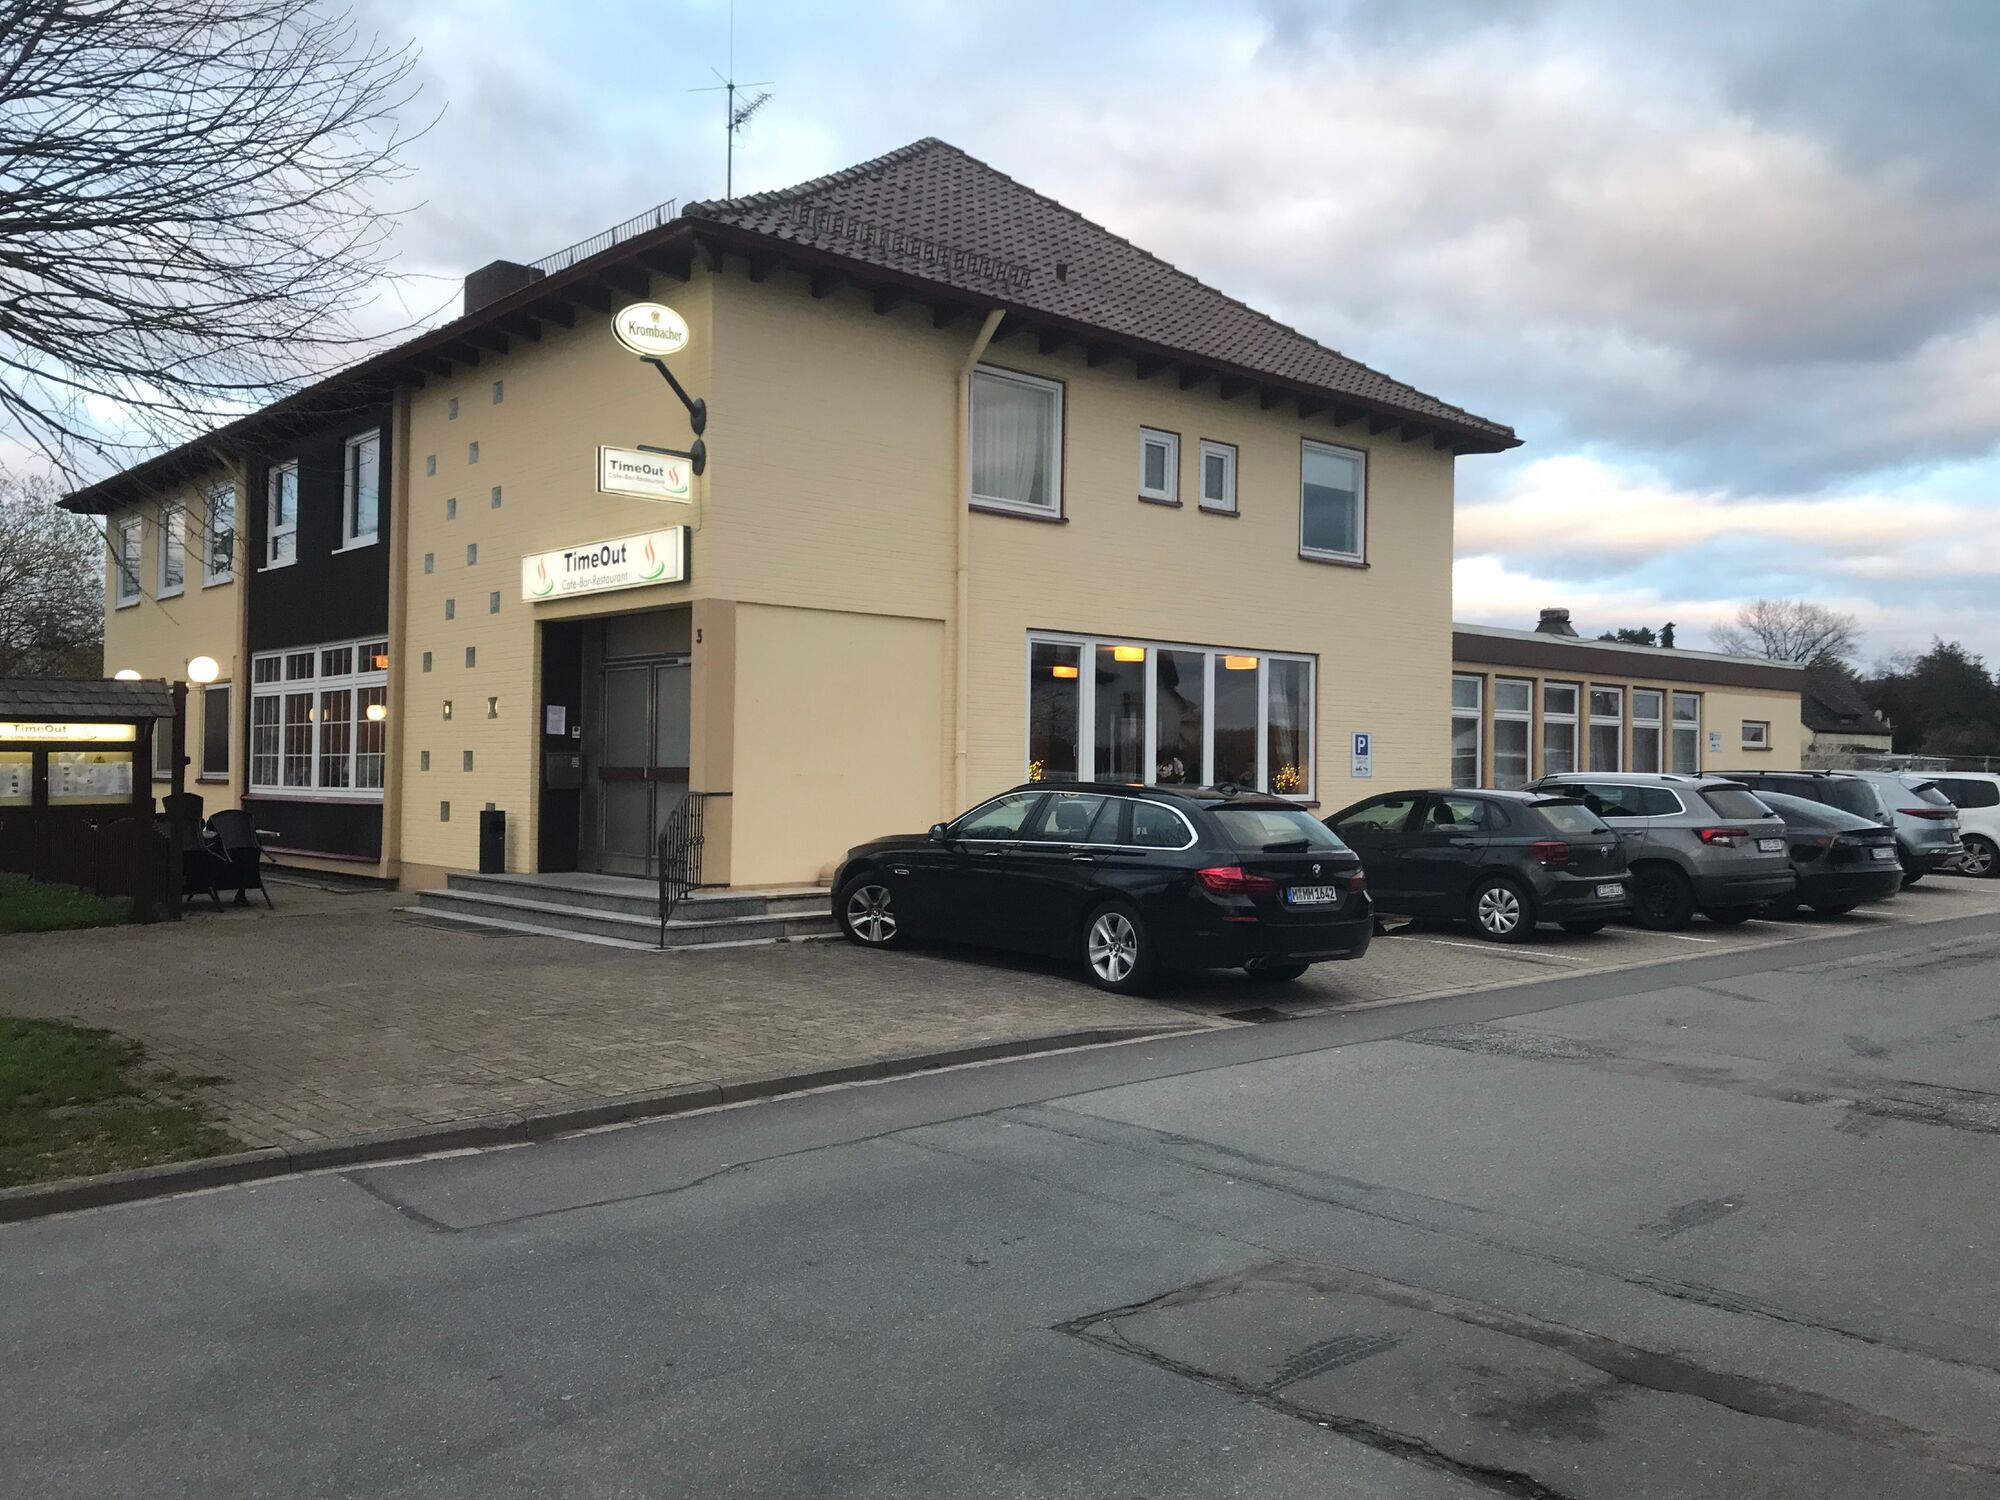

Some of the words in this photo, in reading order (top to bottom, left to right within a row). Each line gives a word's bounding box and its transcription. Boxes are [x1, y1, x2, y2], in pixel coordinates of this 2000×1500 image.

[628, 321, 682, 341] Krombacher
[610, 459, 664, 476] TimeOut
[564, 544, 627, 572] TimeOut
[562, 572, 628, 590] Cafe-Bar-Restaurant
[696, 629, 703, 643] 3
[12, 724, 67, 733] TimeOut
[1357, 736, 1366, 754] P
